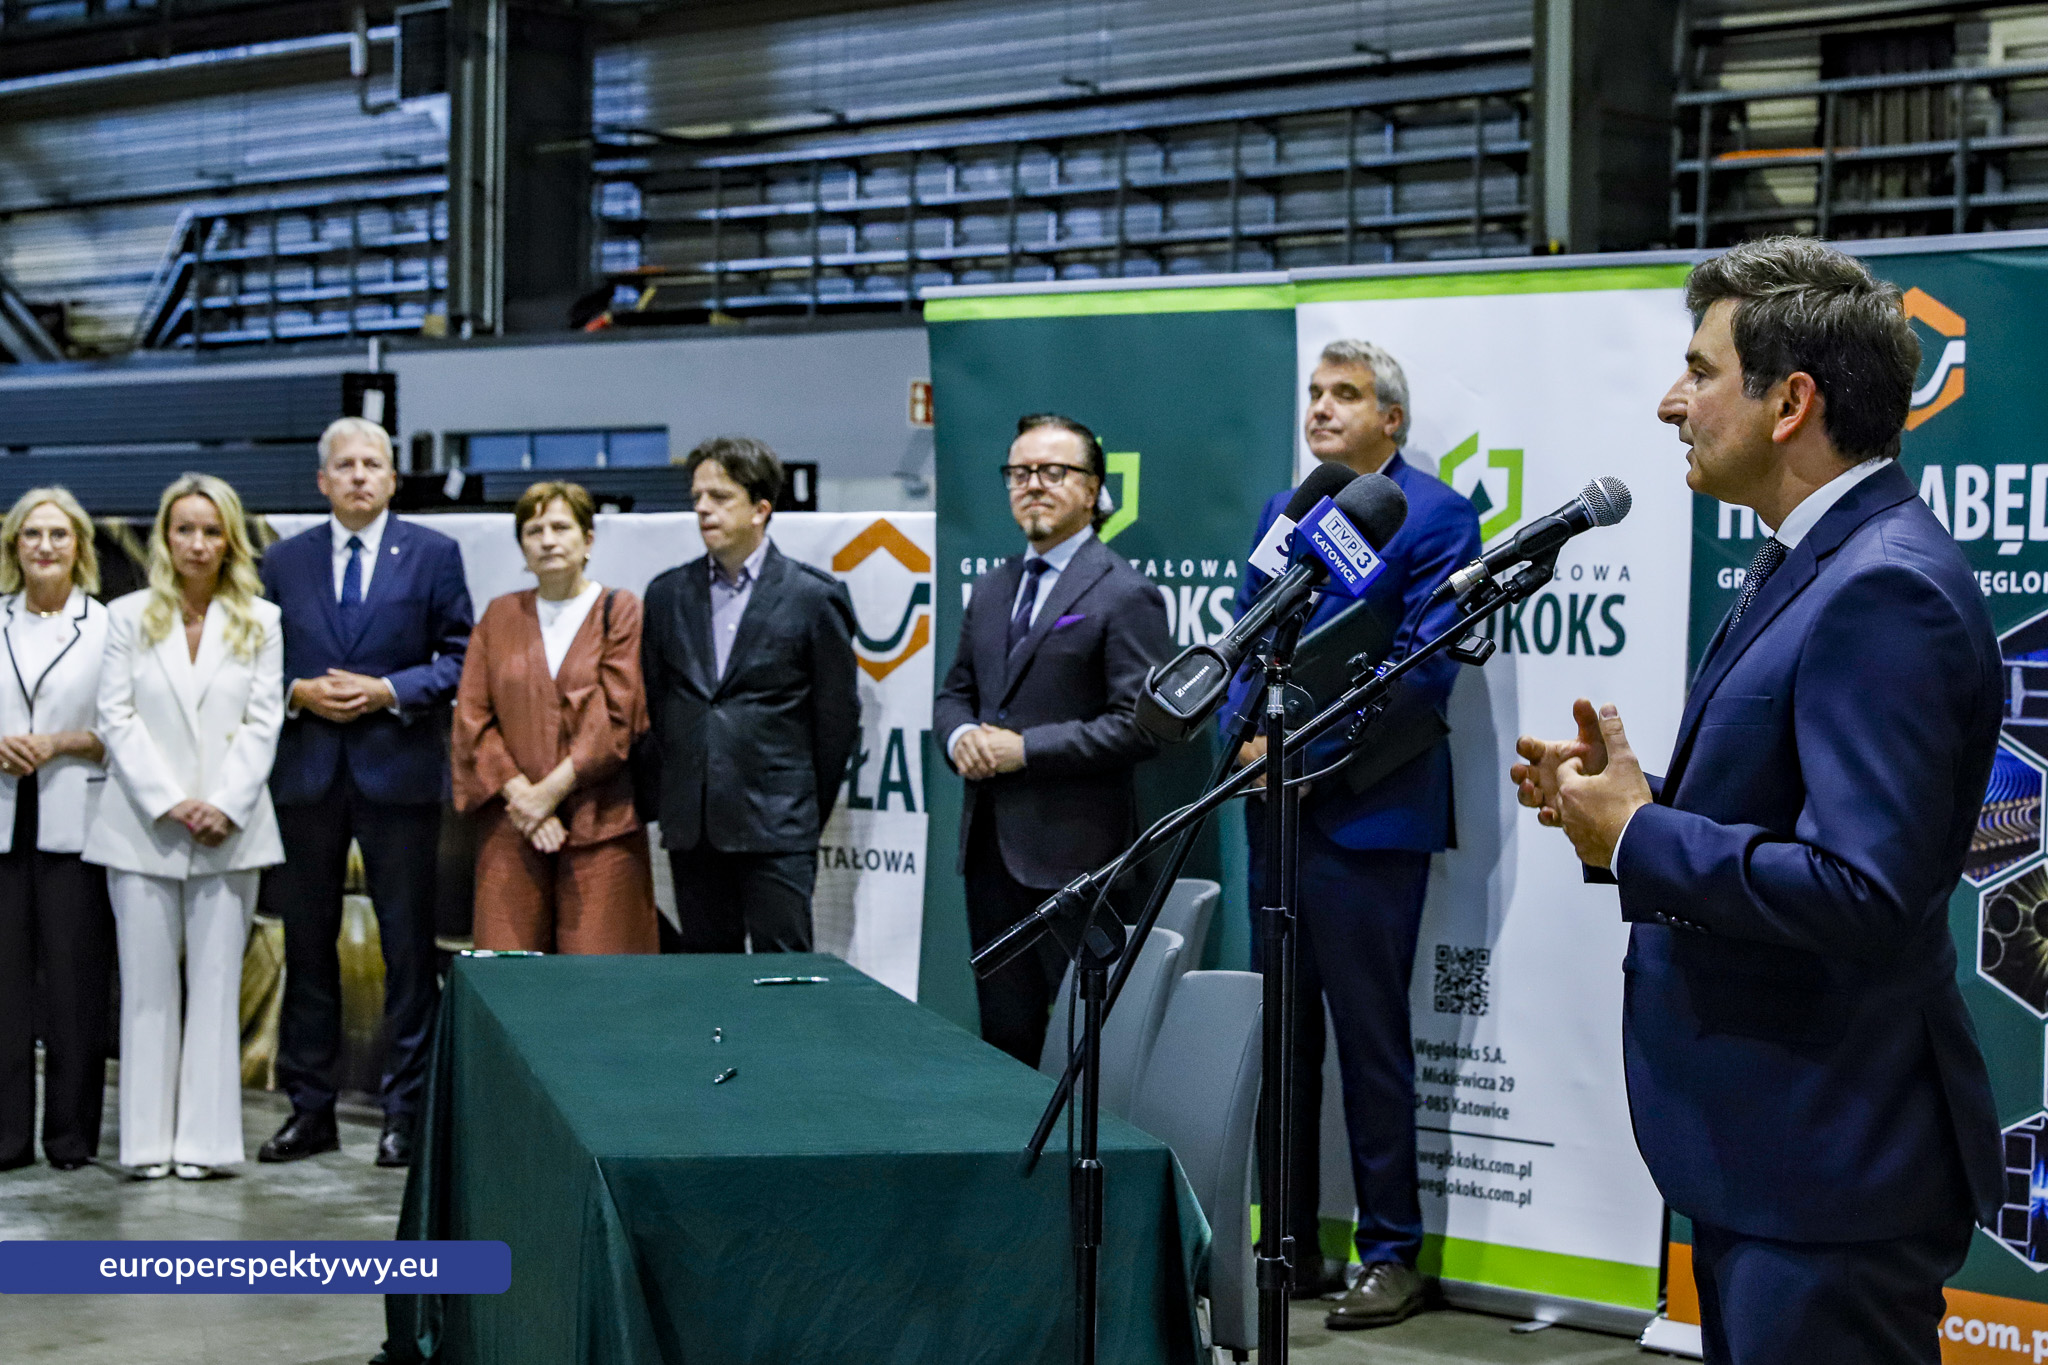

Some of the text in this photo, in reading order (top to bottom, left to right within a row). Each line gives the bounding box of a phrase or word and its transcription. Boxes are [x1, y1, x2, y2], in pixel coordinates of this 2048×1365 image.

[1128, 558, 1238, 578] TAŁOWA
[1312, 532, 1357, 584] KATOWICE
[1502, 563, 1631, 582] ŁOWA
[1973, 570, 2048, 597] ĘGLO
[1486, 592, 1627, 657] KOKS
[820, 846, 917, 875] TAŁOWA
[1482, 1045, 1507, 1064] S.A.
[1422, 1066, 1516, 1092] Mickiewicza 29
[1452, 1098, 1510, 1120] Katowice
[1417, 1150, 1532, 1180] weglokoks.com.pl
[1418, 1178, 1532, 1208] weglokoks.com.pl
